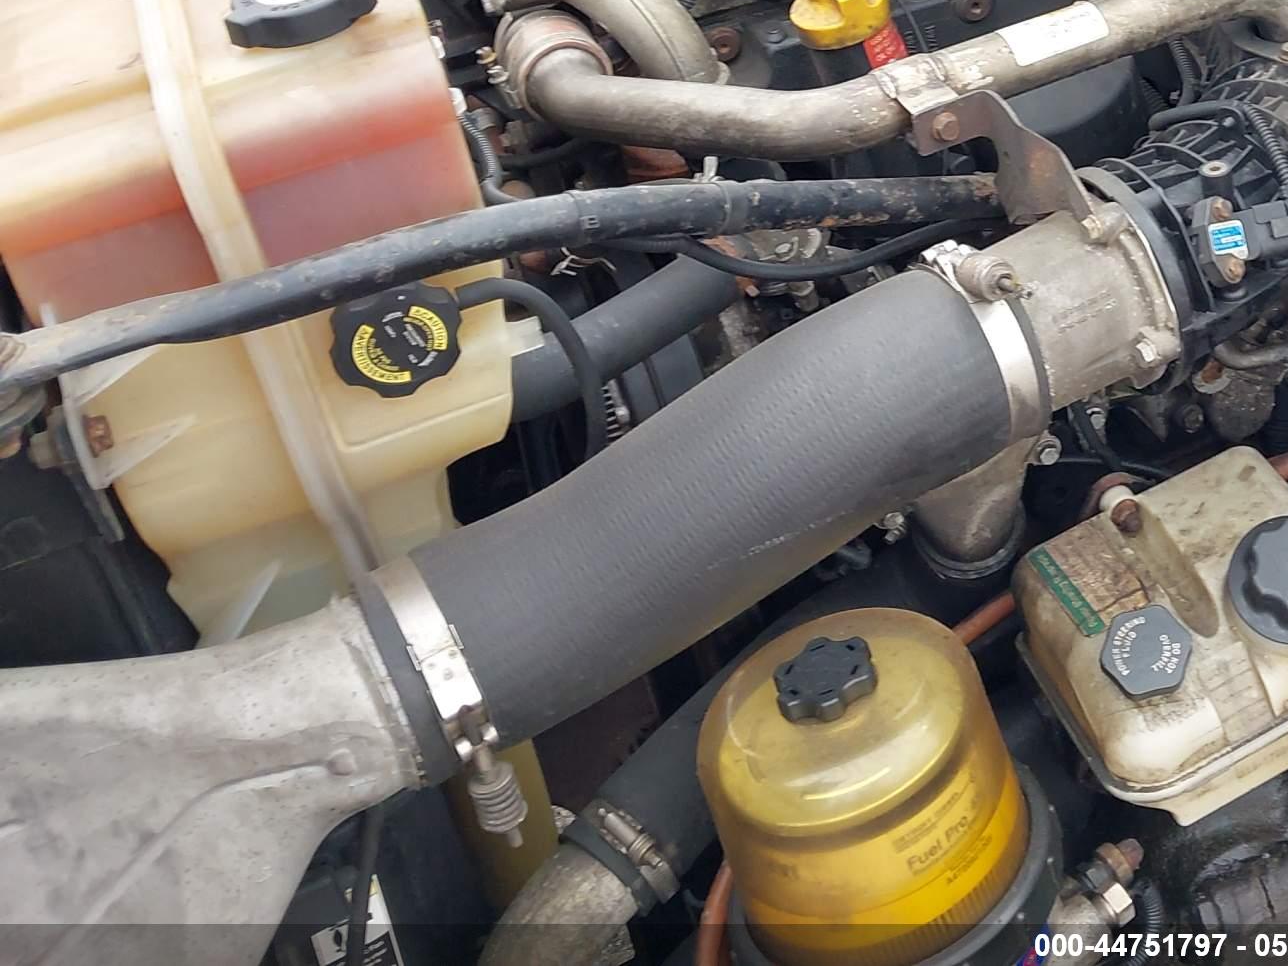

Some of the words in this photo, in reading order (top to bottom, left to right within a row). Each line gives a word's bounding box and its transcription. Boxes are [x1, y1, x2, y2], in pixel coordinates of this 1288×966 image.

[1113, 616, 1146, 646] STEERING
[1121, 631, 1137, 658] FLUID
[1111, 647, 1130, 676] POWER
[1151, 634, 1173, 672] OVERFILL
[1165, 655, 1180, 674] NOT
[906, 838, 943, 871] Fuel
[945, 815, 969, 844] Pro
